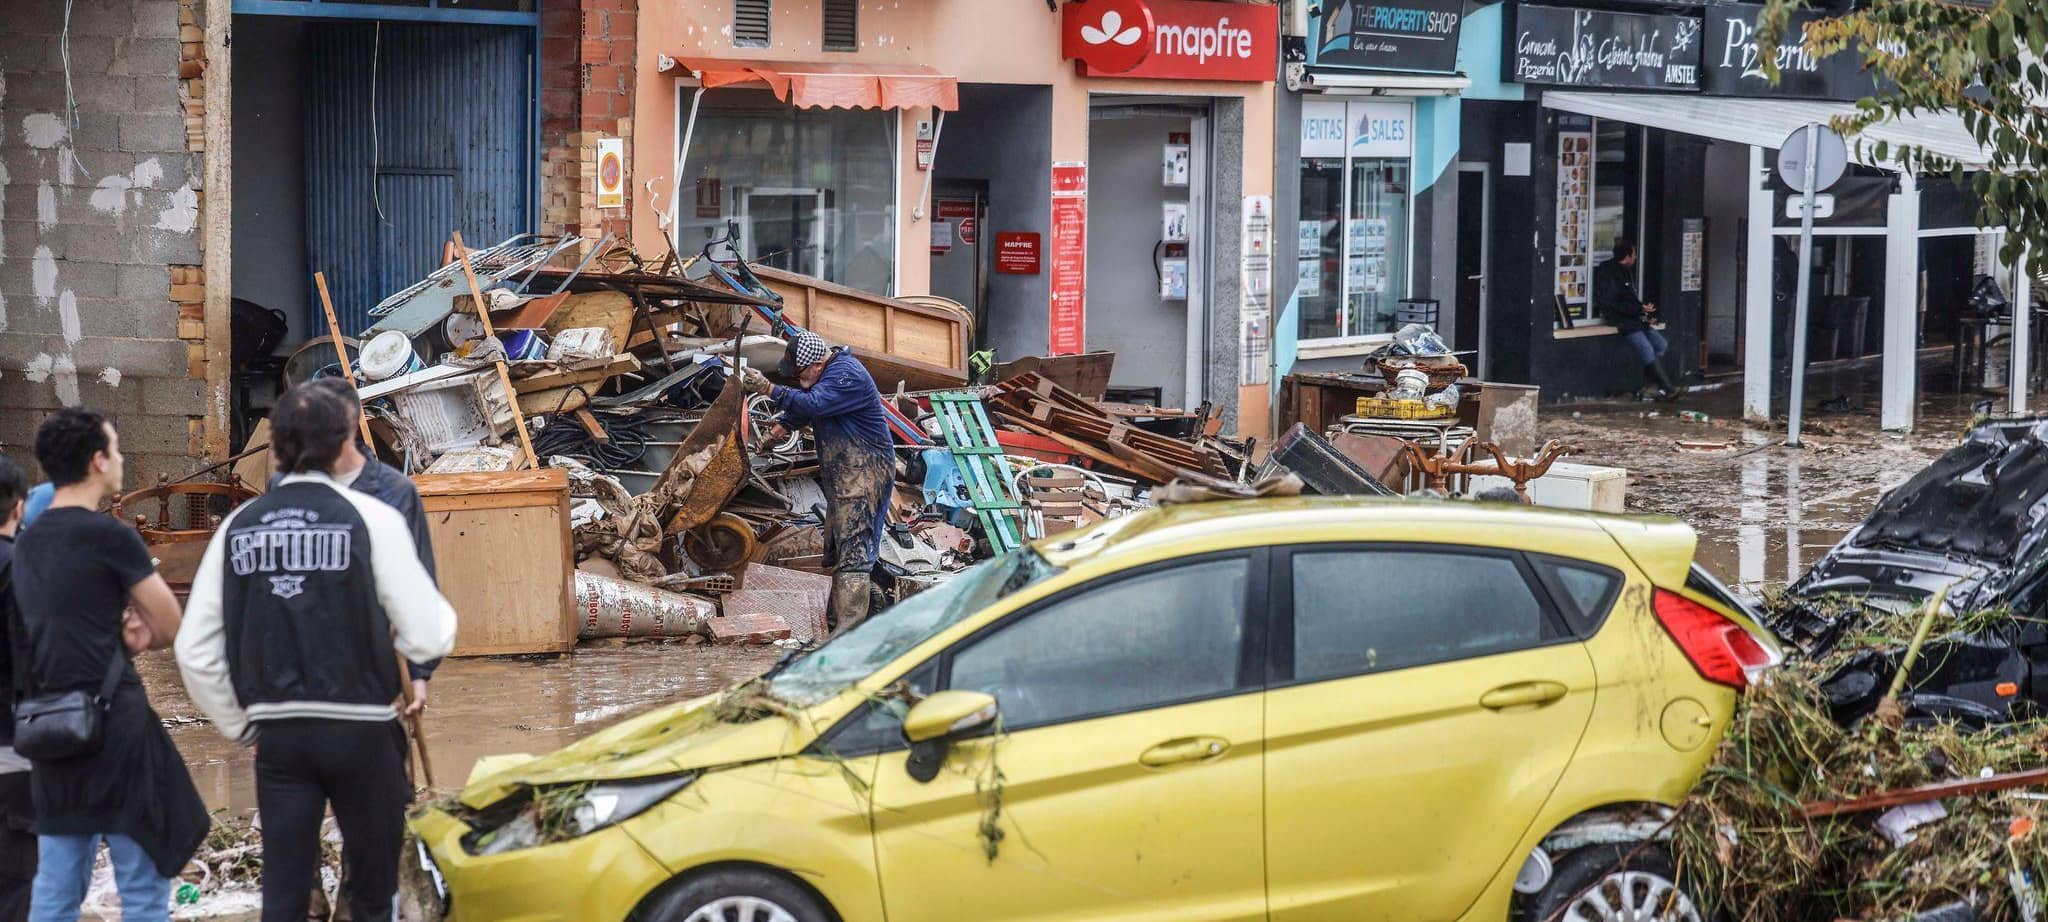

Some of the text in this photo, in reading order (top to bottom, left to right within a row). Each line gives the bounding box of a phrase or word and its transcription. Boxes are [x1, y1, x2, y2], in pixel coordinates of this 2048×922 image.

[1155, 17, 1252, 64] mapfre
[1720, 18, 1819, 80] Pizería
[1665, 64, 1697, 84] AMSTEL
[1302, 118, 1343, 140] VENTAS
[1371, 119, 1405, 141] SALES
[1004, 241, 1032, 249] MAPFRE
